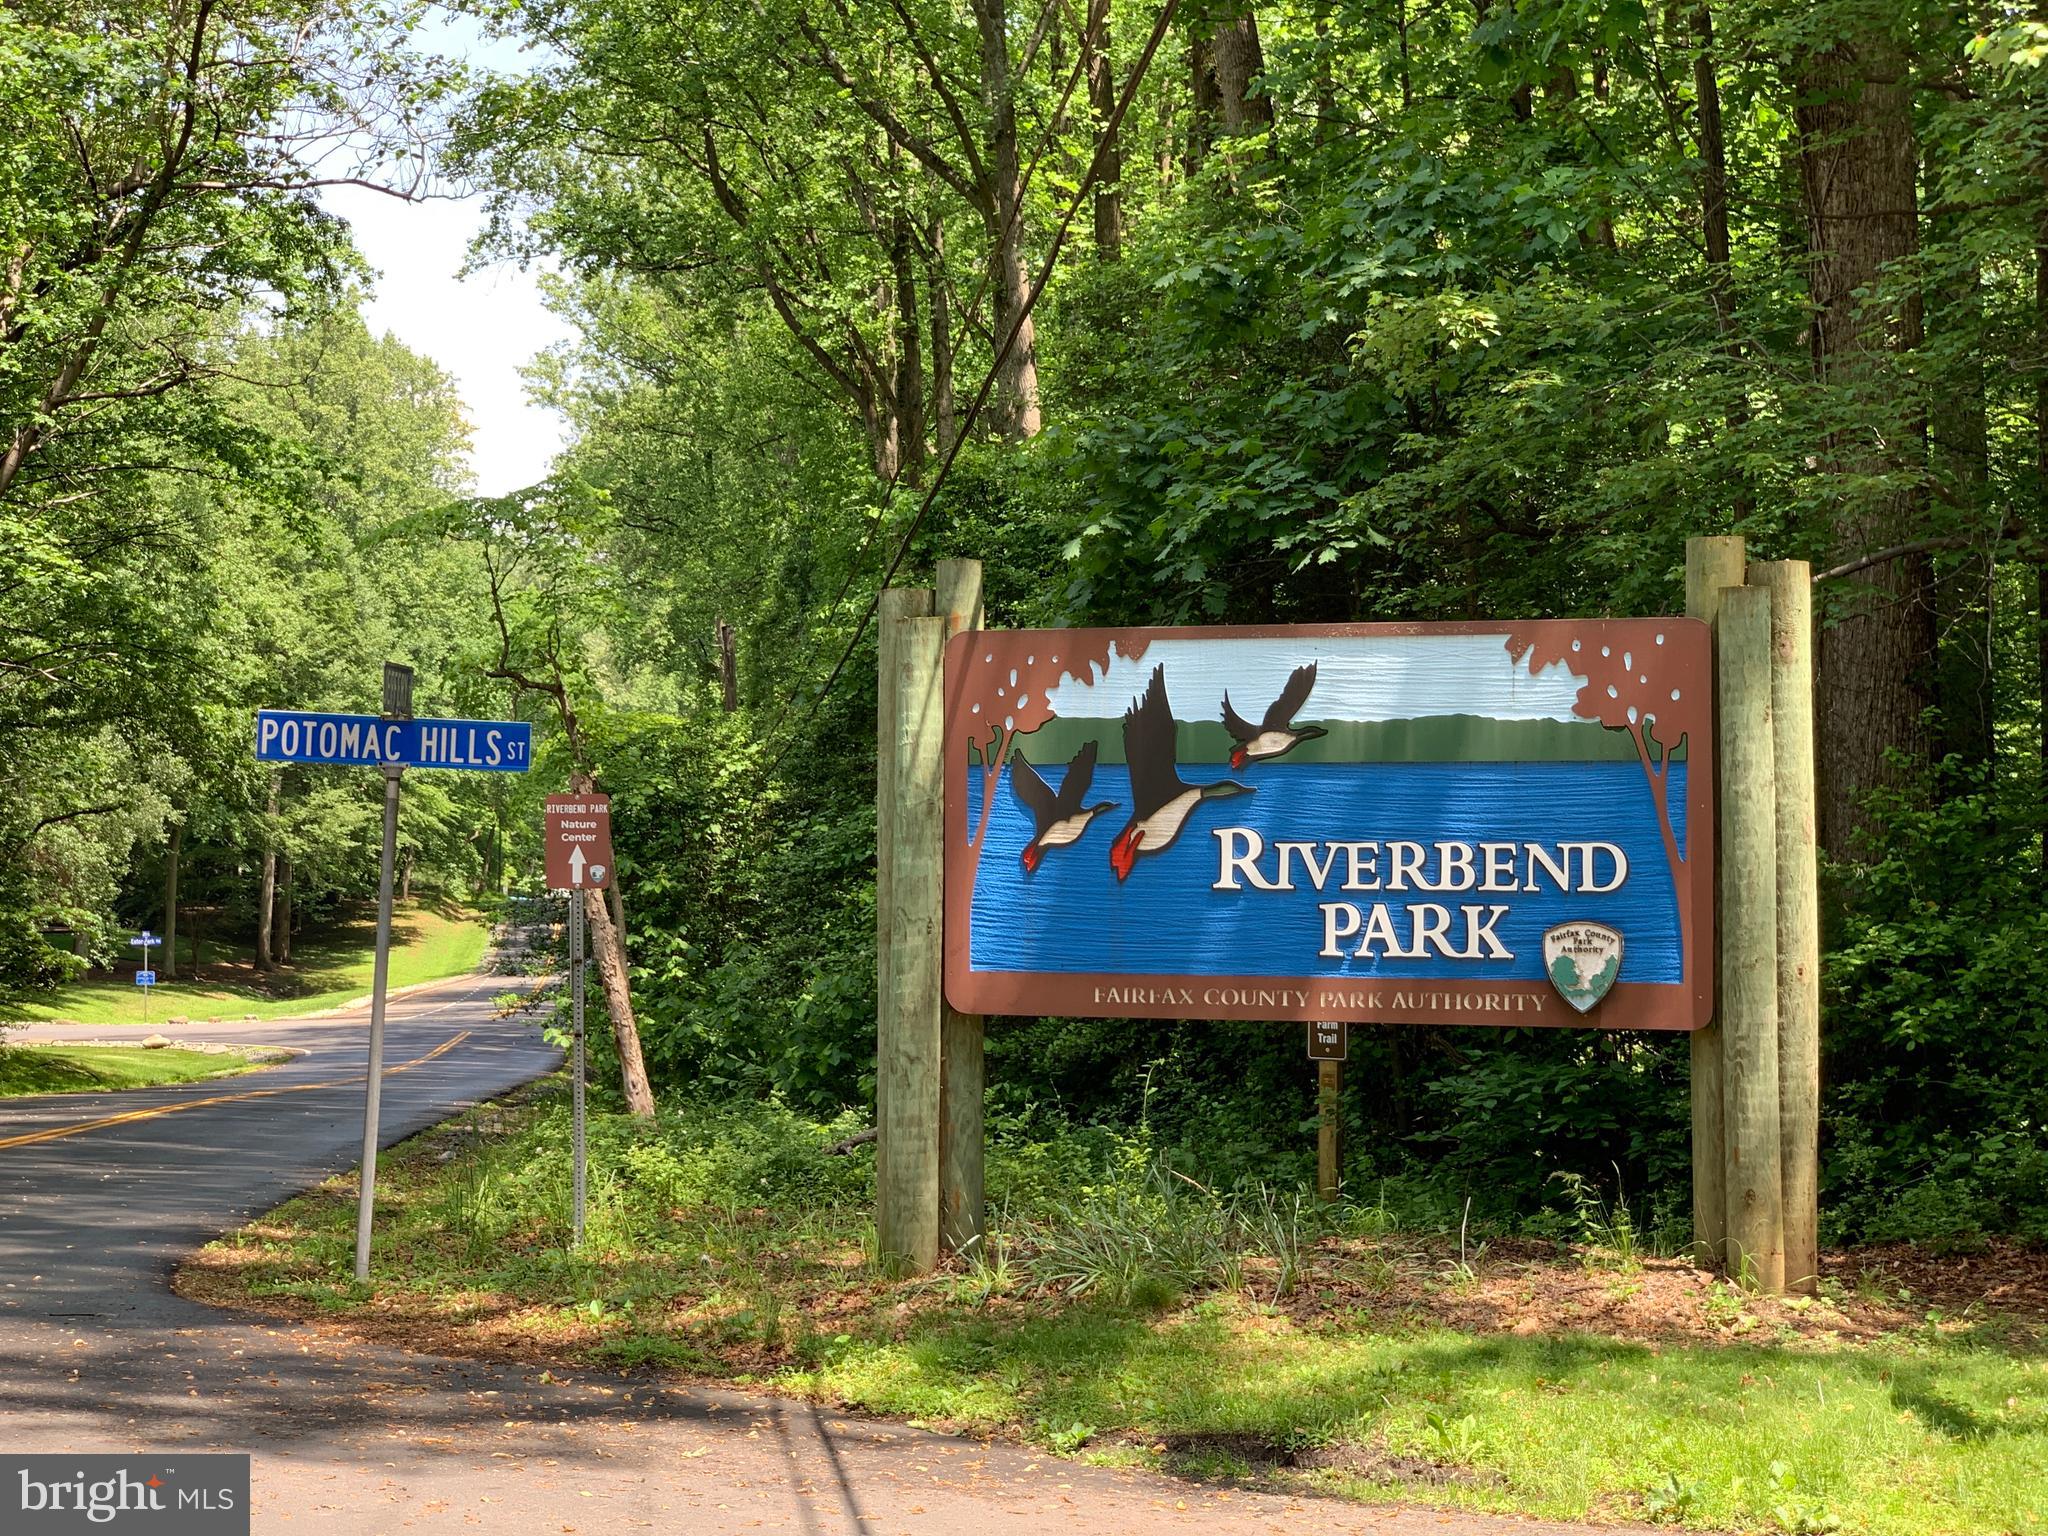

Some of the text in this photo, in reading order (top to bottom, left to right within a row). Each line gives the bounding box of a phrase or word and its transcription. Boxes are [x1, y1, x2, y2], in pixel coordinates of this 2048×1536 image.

[261, 719, 526, 766] POTOMAC HILLS ST
[546, 804, 608, 813] RIVERBEND PARK
[561, 820, 597, 829] Nature
[561, 833, 597, 842] Center
[1212, 827, 1629, 893] RIVERBEND
[1318, 902, 1515, 960] PARK
[1550, 929, 1616, 945] Fairfax County
[1573, 937, 1593, 945] Park
[1561, 945, 1604, 955] Authority
[1094, 987, 1547, 1012] FAIRFAX COUNTY PARK AUTHORITY
[1317, 1021, 1338, 1029] Farm
[1317, 1033, 1337, 1044] Trail
